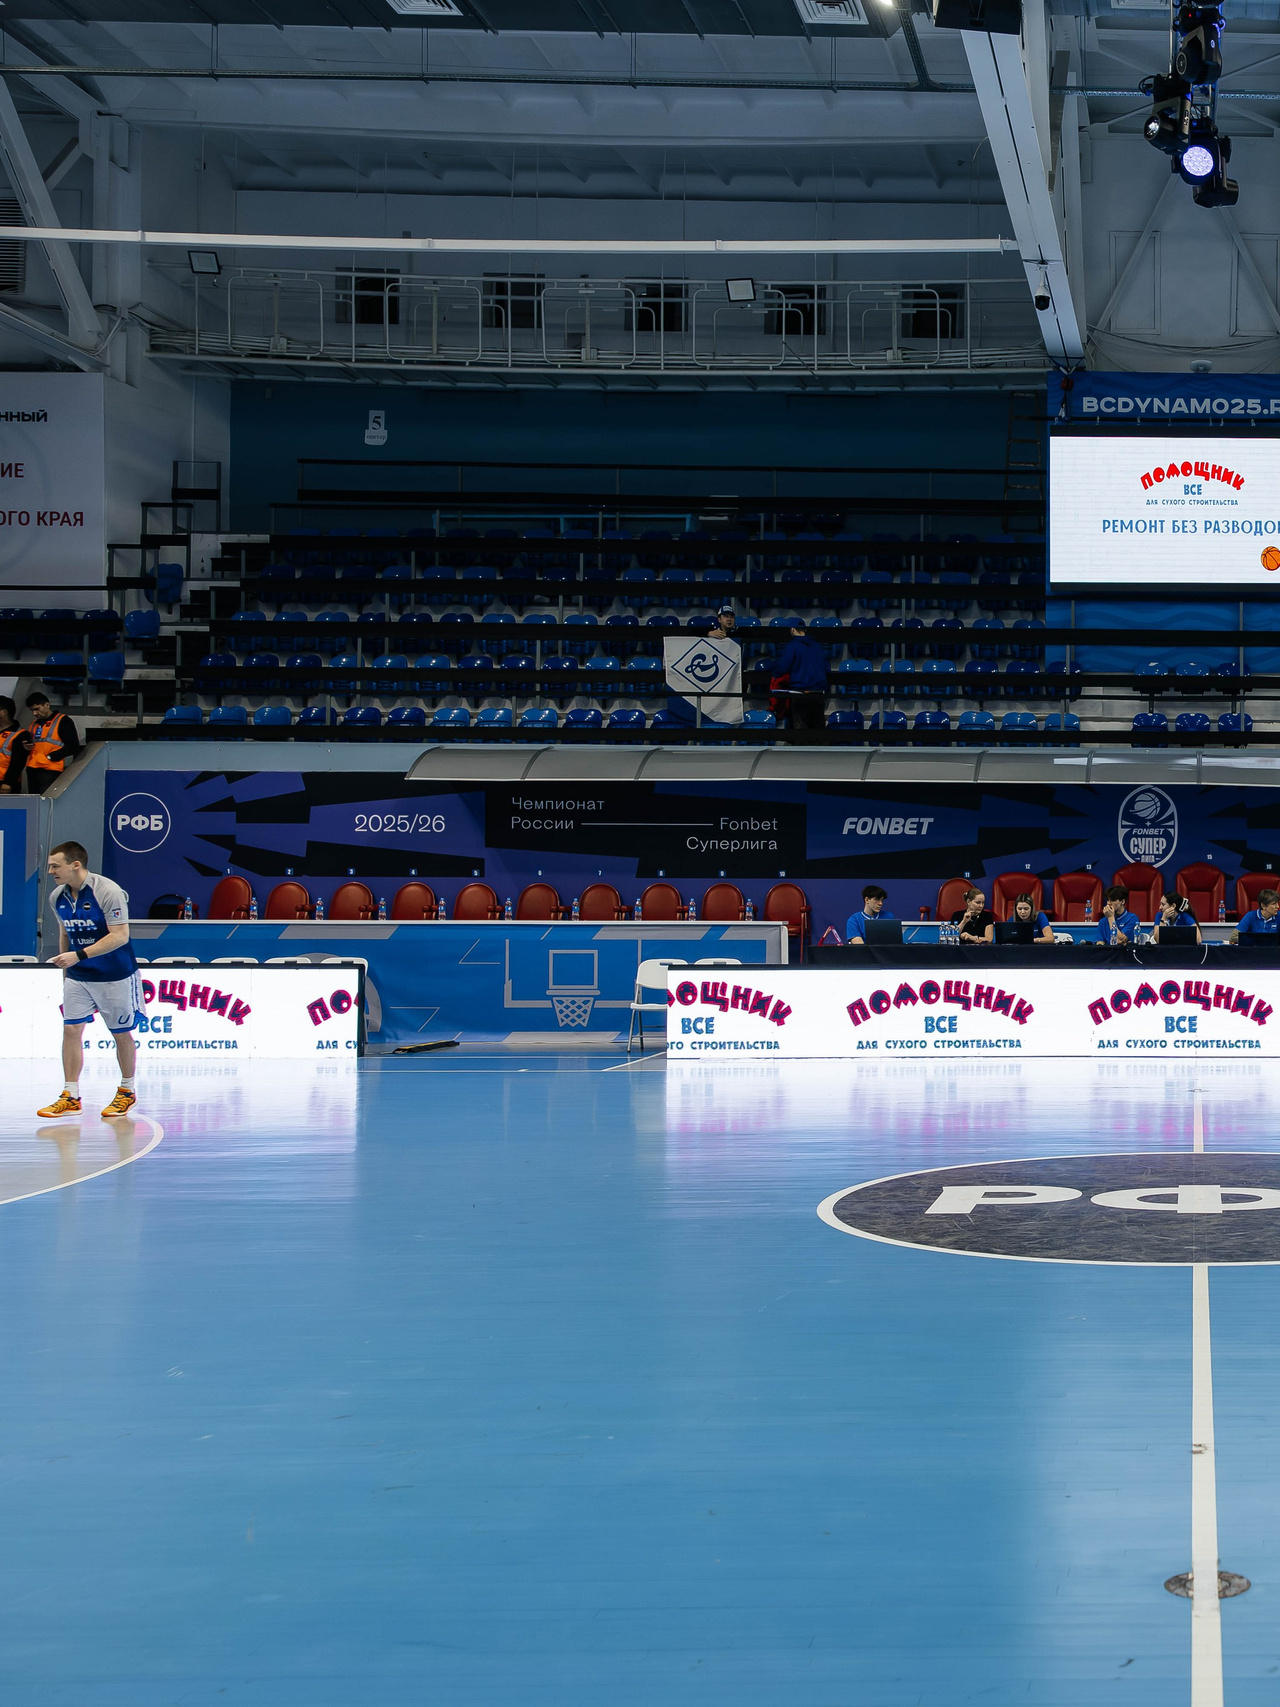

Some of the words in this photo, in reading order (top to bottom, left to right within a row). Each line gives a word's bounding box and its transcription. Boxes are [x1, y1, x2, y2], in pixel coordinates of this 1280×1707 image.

[371, 415, 382, 431] 5
[1140, 461, 1245, 491] ПОМОЩНИК
[1183, 483, 1202, 496] ВСЕ
[37, 511, 84, 527] КРАЯ
[1102, 519, 1166, 533] РЕМОНТ
[1172, 519, 1198, 533] БЕЗ
[511, 797, 605, 810] Чемпионат
[117, 814, 164, 831] РФБ
[355, 814, 446, 834] 2025/26
[511, 817, 574, 830] России
[720, 818, 778, 831] Fonbet
[842, 817, 934, 835] FONBET
[686, 836, 778, 852] Суперлига
[1130, 837, 1167, 854] СУПЕР
[142, 979, 252, 1026] ОЩНИК
[307, 989, 359, 1026] ПО
[667, 980, 792, 1027] ОЩНИК
[846, 980, 1035, 1027] ПОМОЩНИК
[1087, 980, 1274, 1026] ПОМОЩНИК
[139, 1016, 172, 1033] ВСЕ
[681, 1016, 715, 1034] ВСЕ
[924, 1015, 958, 1033] ВСЕ
[1164, 1015, 1198, 1033] ВСЕ
[148, 1040, 238, 1050] СТРОИТЕЛЬСТВА
[316, 1040, 338, 1050] ДЛЯ
[690, 1041, 780, 1050] СТРОИТЕЛЬСТВА
[856, 1040, 878, 1050] ДЛЯ
[885, 1040, 927, 1049] СУХОГО
[933, 1039, 1022, 1049] СТРОИТЕЛЬСТВА
[1097, 1039, 1119, 1049] ДЛЯ
[1126, 1039, 1167, 1049] СУХОГО
[1173, 1039, 1261, 1049] СТРОИТЕЛЬСТВА
